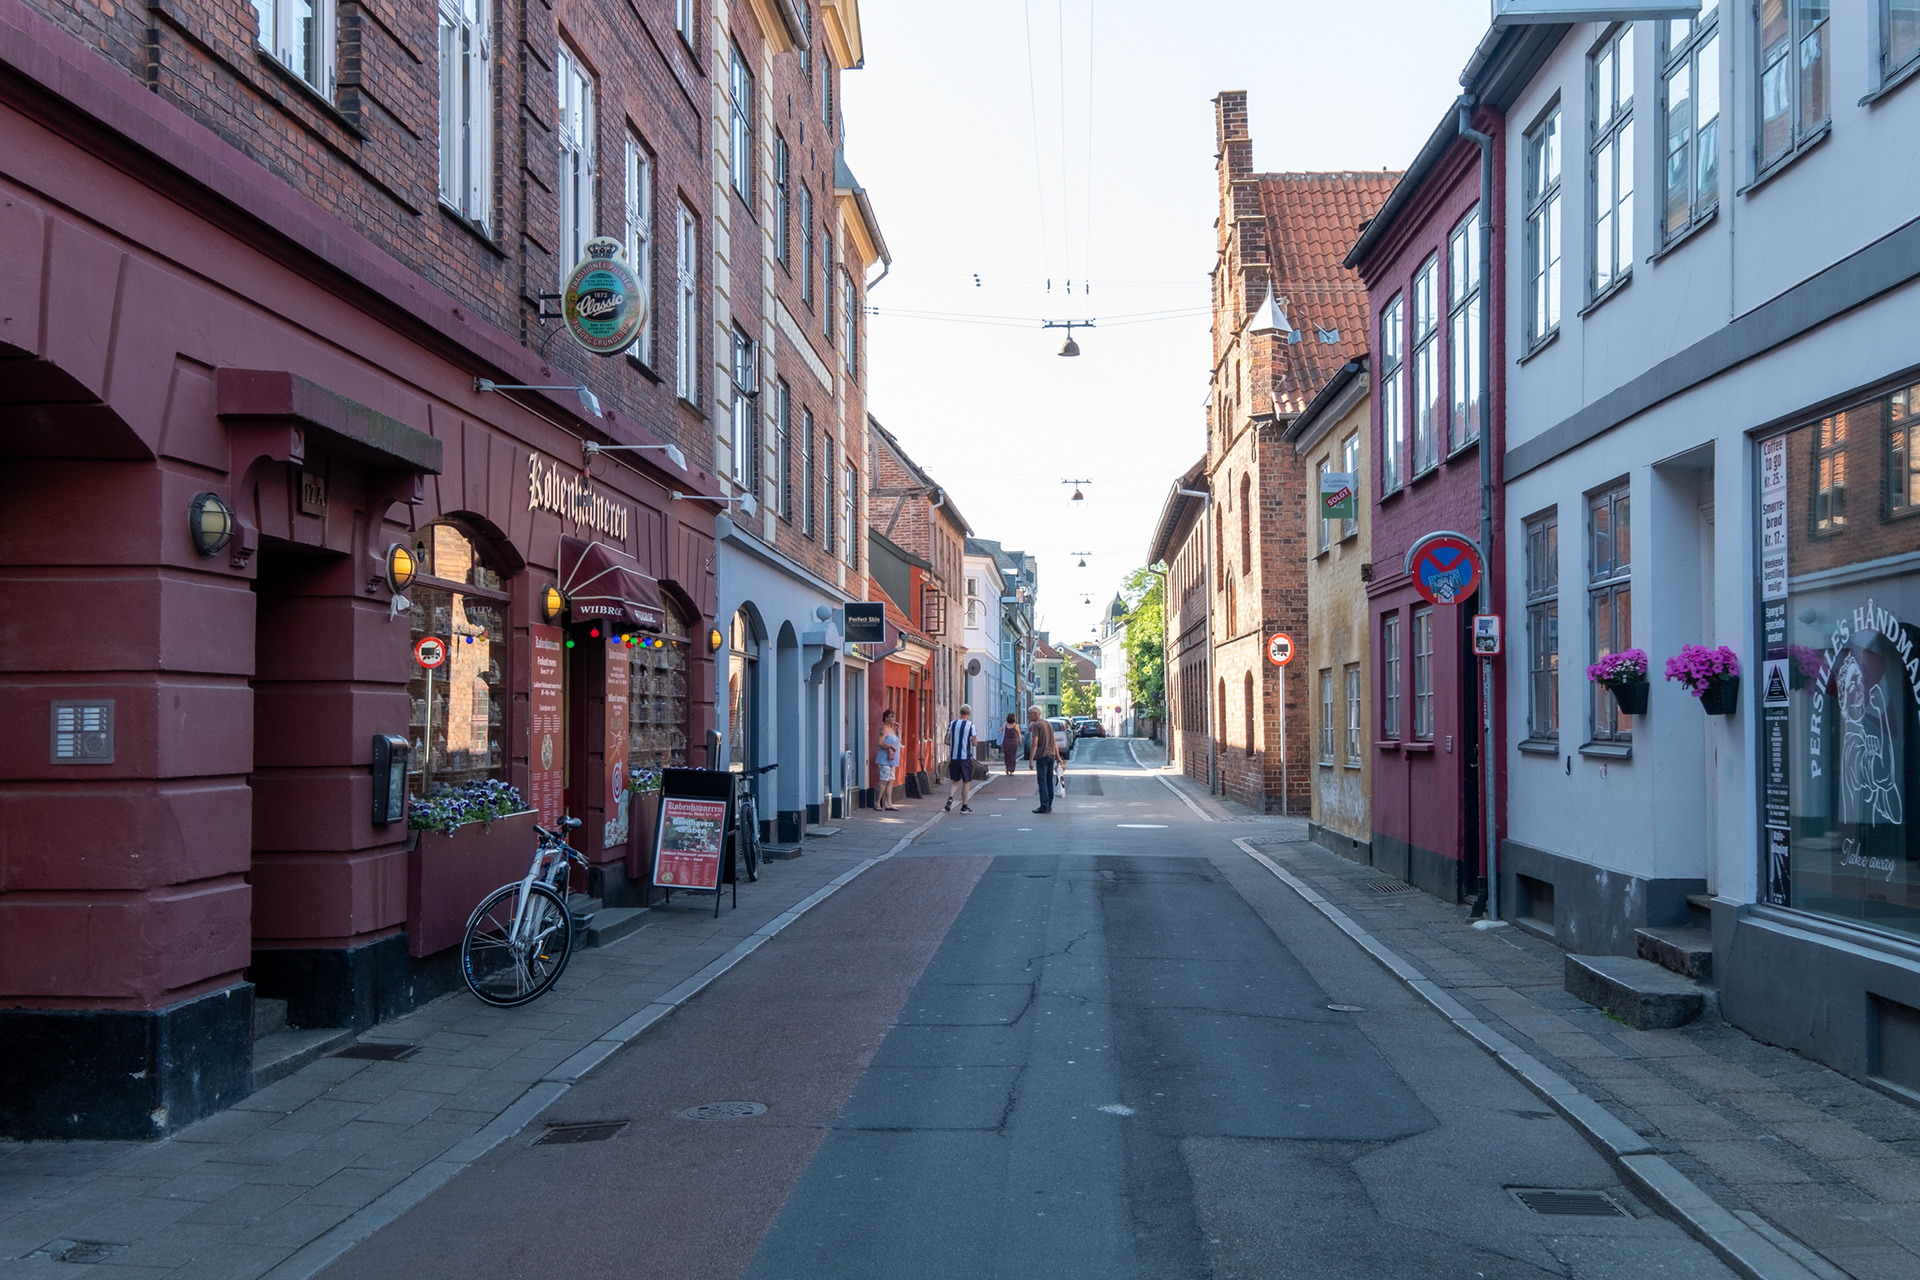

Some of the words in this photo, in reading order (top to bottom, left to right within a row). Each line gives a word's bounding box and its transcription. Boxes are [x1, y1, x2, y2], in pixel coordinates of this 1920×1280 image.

[572, 262, 607, 289] TRADITIONEL
[609, 264, 633, 291] PILSNER
[576, 294, 624, 317] Classic
[572, 320, 592, 343] TUBORG
[1764, 440, 1783, 456] Coffee
[1765, 457, 1772, 471] to
[1773, 454, 1781, 471] go
[528, 452, 627, 541] Københavneren
[1327, 488, 1349, 507] SOLGT
[1763, 500, 1785, 515] Smørre-
[1766, 514, 1782, 529] brød
[1764, 534, 1773, 547] Kr.
[1810, 618, 1850, 779] PERSILLE'S
[1840, 838, 1868, 867] Take
[1869, 856, 1896, 882] away
